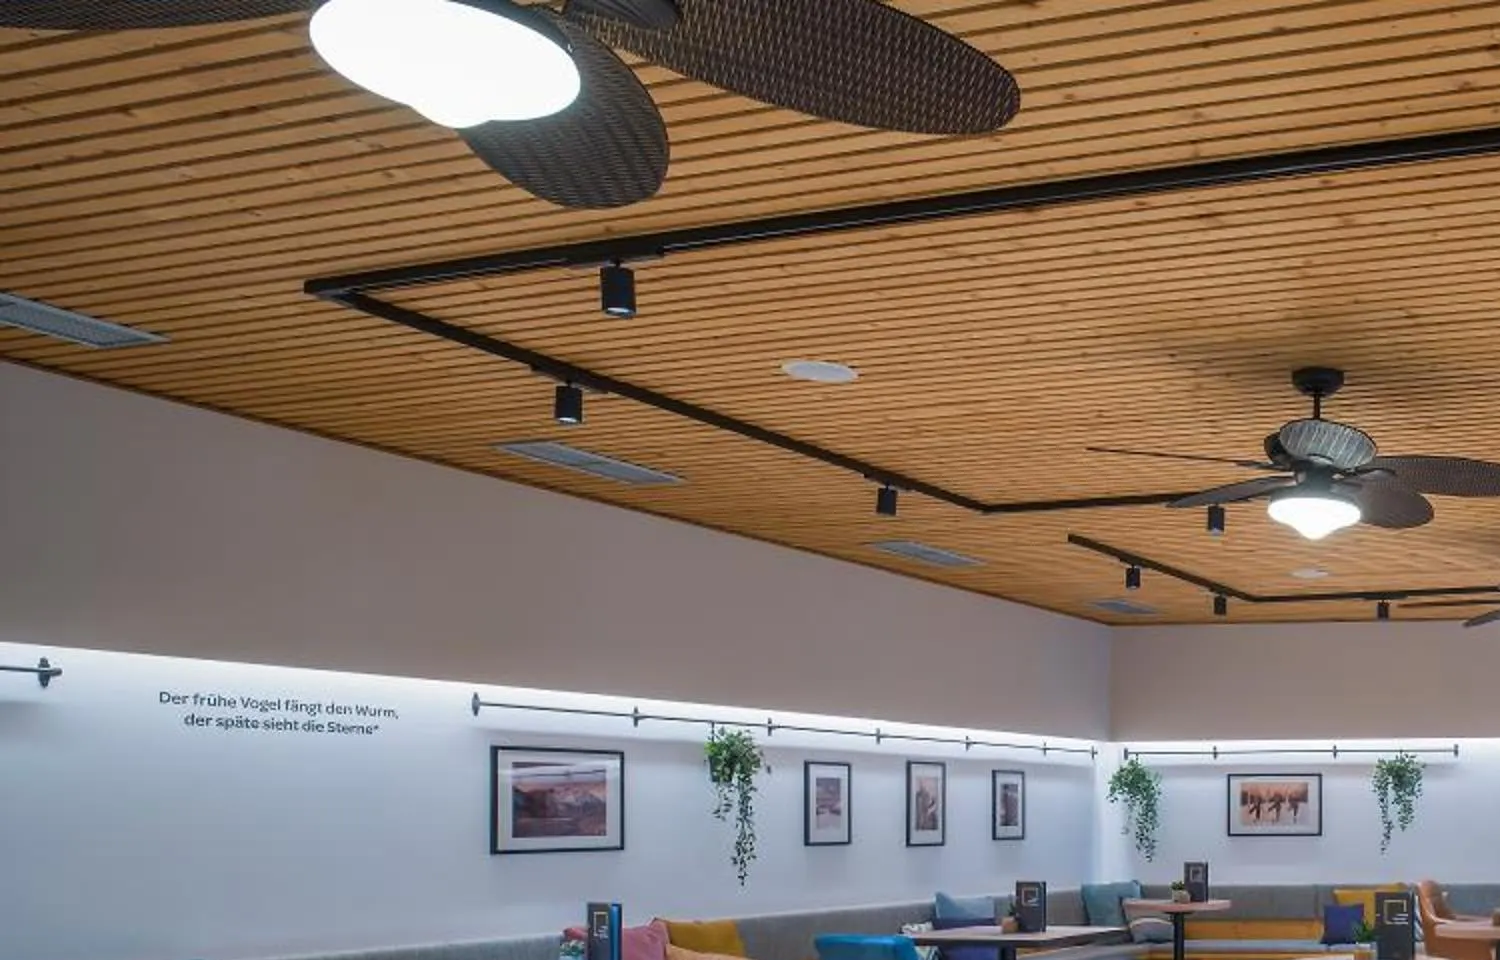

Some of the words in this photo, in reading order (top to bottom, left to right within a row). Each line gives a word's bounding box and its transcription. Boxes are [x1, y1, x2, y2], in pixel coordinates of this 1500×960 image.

[159, 691, 188, 705] Der
[192, 693, 237, 709] frühe
[240, 696, 281, 712] Vogel
[284, 699, 322, 717] fängt
[325, 701, 352, 715] den
[355, 704, 400, 720] Wurm,
[184, 713, 213, 727] der
[215, 715, 259, 730] späte
[262, 717, 300, 732] sieht
[301, 719, 325, 733] die
